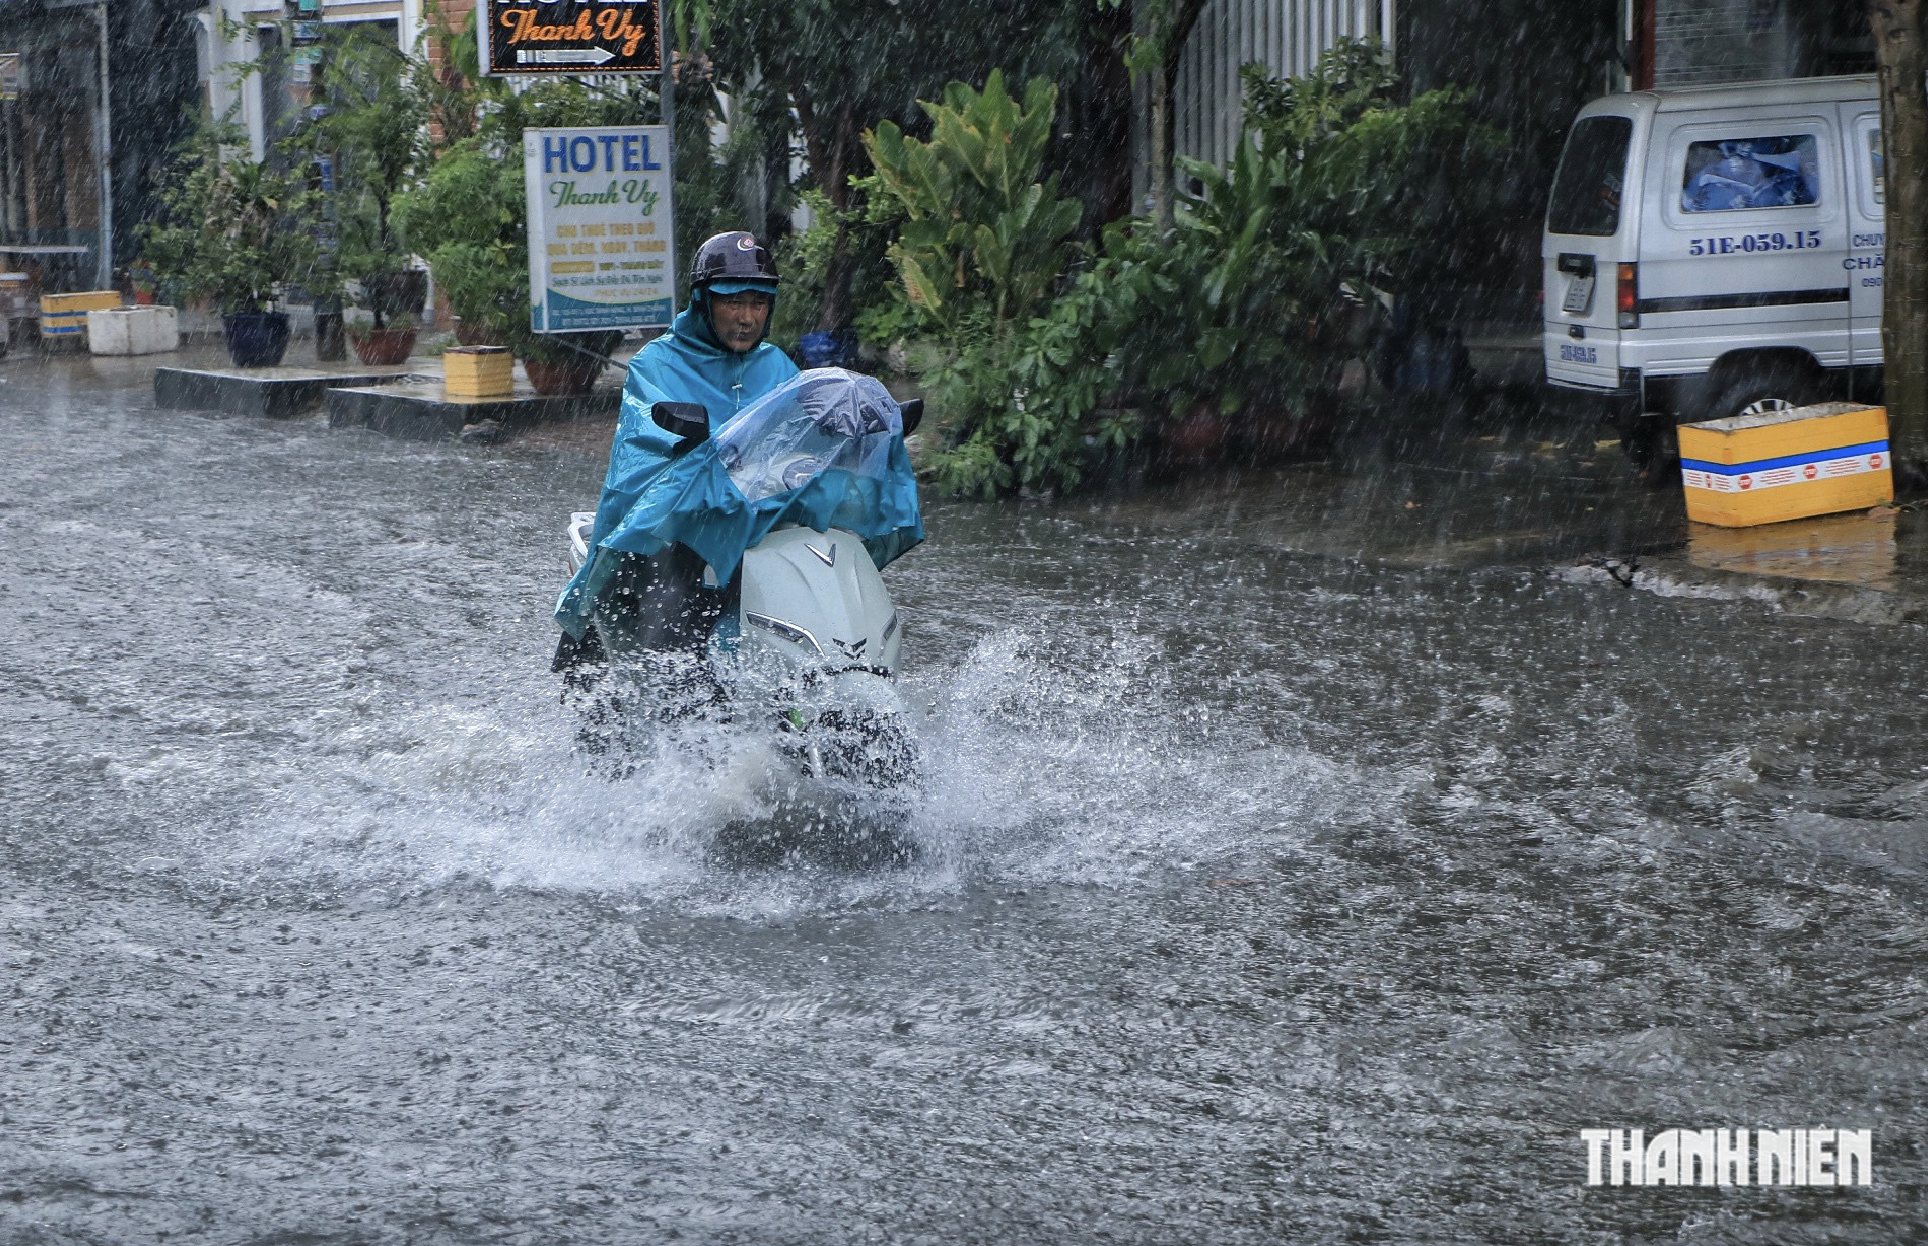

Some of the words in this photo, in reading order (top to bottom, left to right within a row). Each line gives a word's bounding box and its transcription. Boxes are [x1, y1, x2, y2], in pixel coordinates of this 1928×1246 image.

[500, 8, 596, 44] Thanh
[596, 8, 646, 57] Vy
[543, 134, 662, 174] HOTEL
[549, 180, 620, 208] Thanh
[621, 179, 660, 216] Vy
[1689, 230, 1821, 256] 51E-059.15
